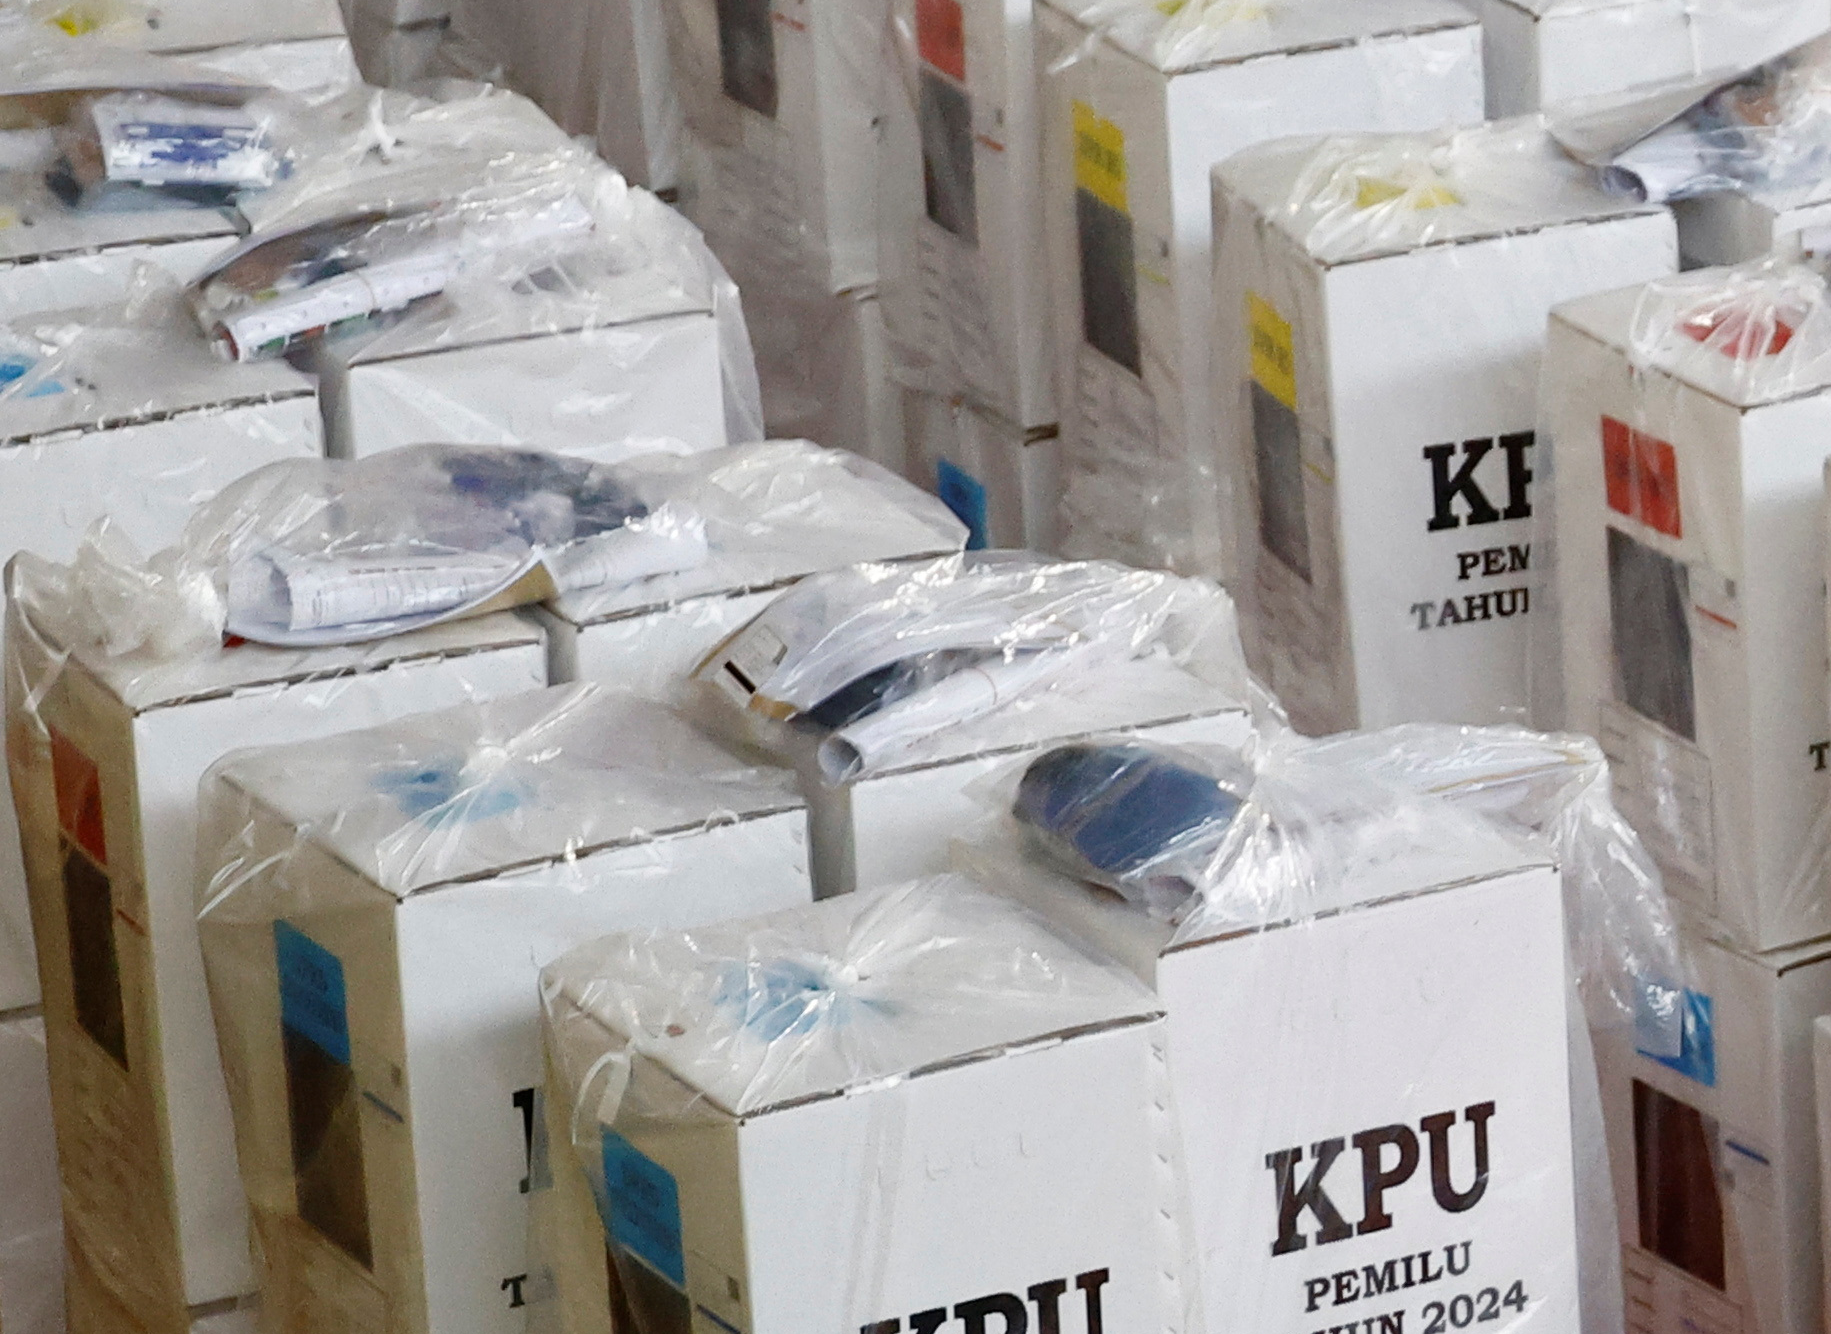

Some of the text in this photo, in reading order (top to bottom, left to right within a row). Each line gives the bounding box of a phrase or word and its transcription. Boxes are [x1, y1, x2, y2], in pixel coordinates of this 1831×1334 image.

[1422, 430, 1535, 533] KP
[1410, 588, 1529, 632] TAHU
[1265, 1101, 1496, 1258] KPU
[1303, 1240, 1474, 1313] PEMILU
